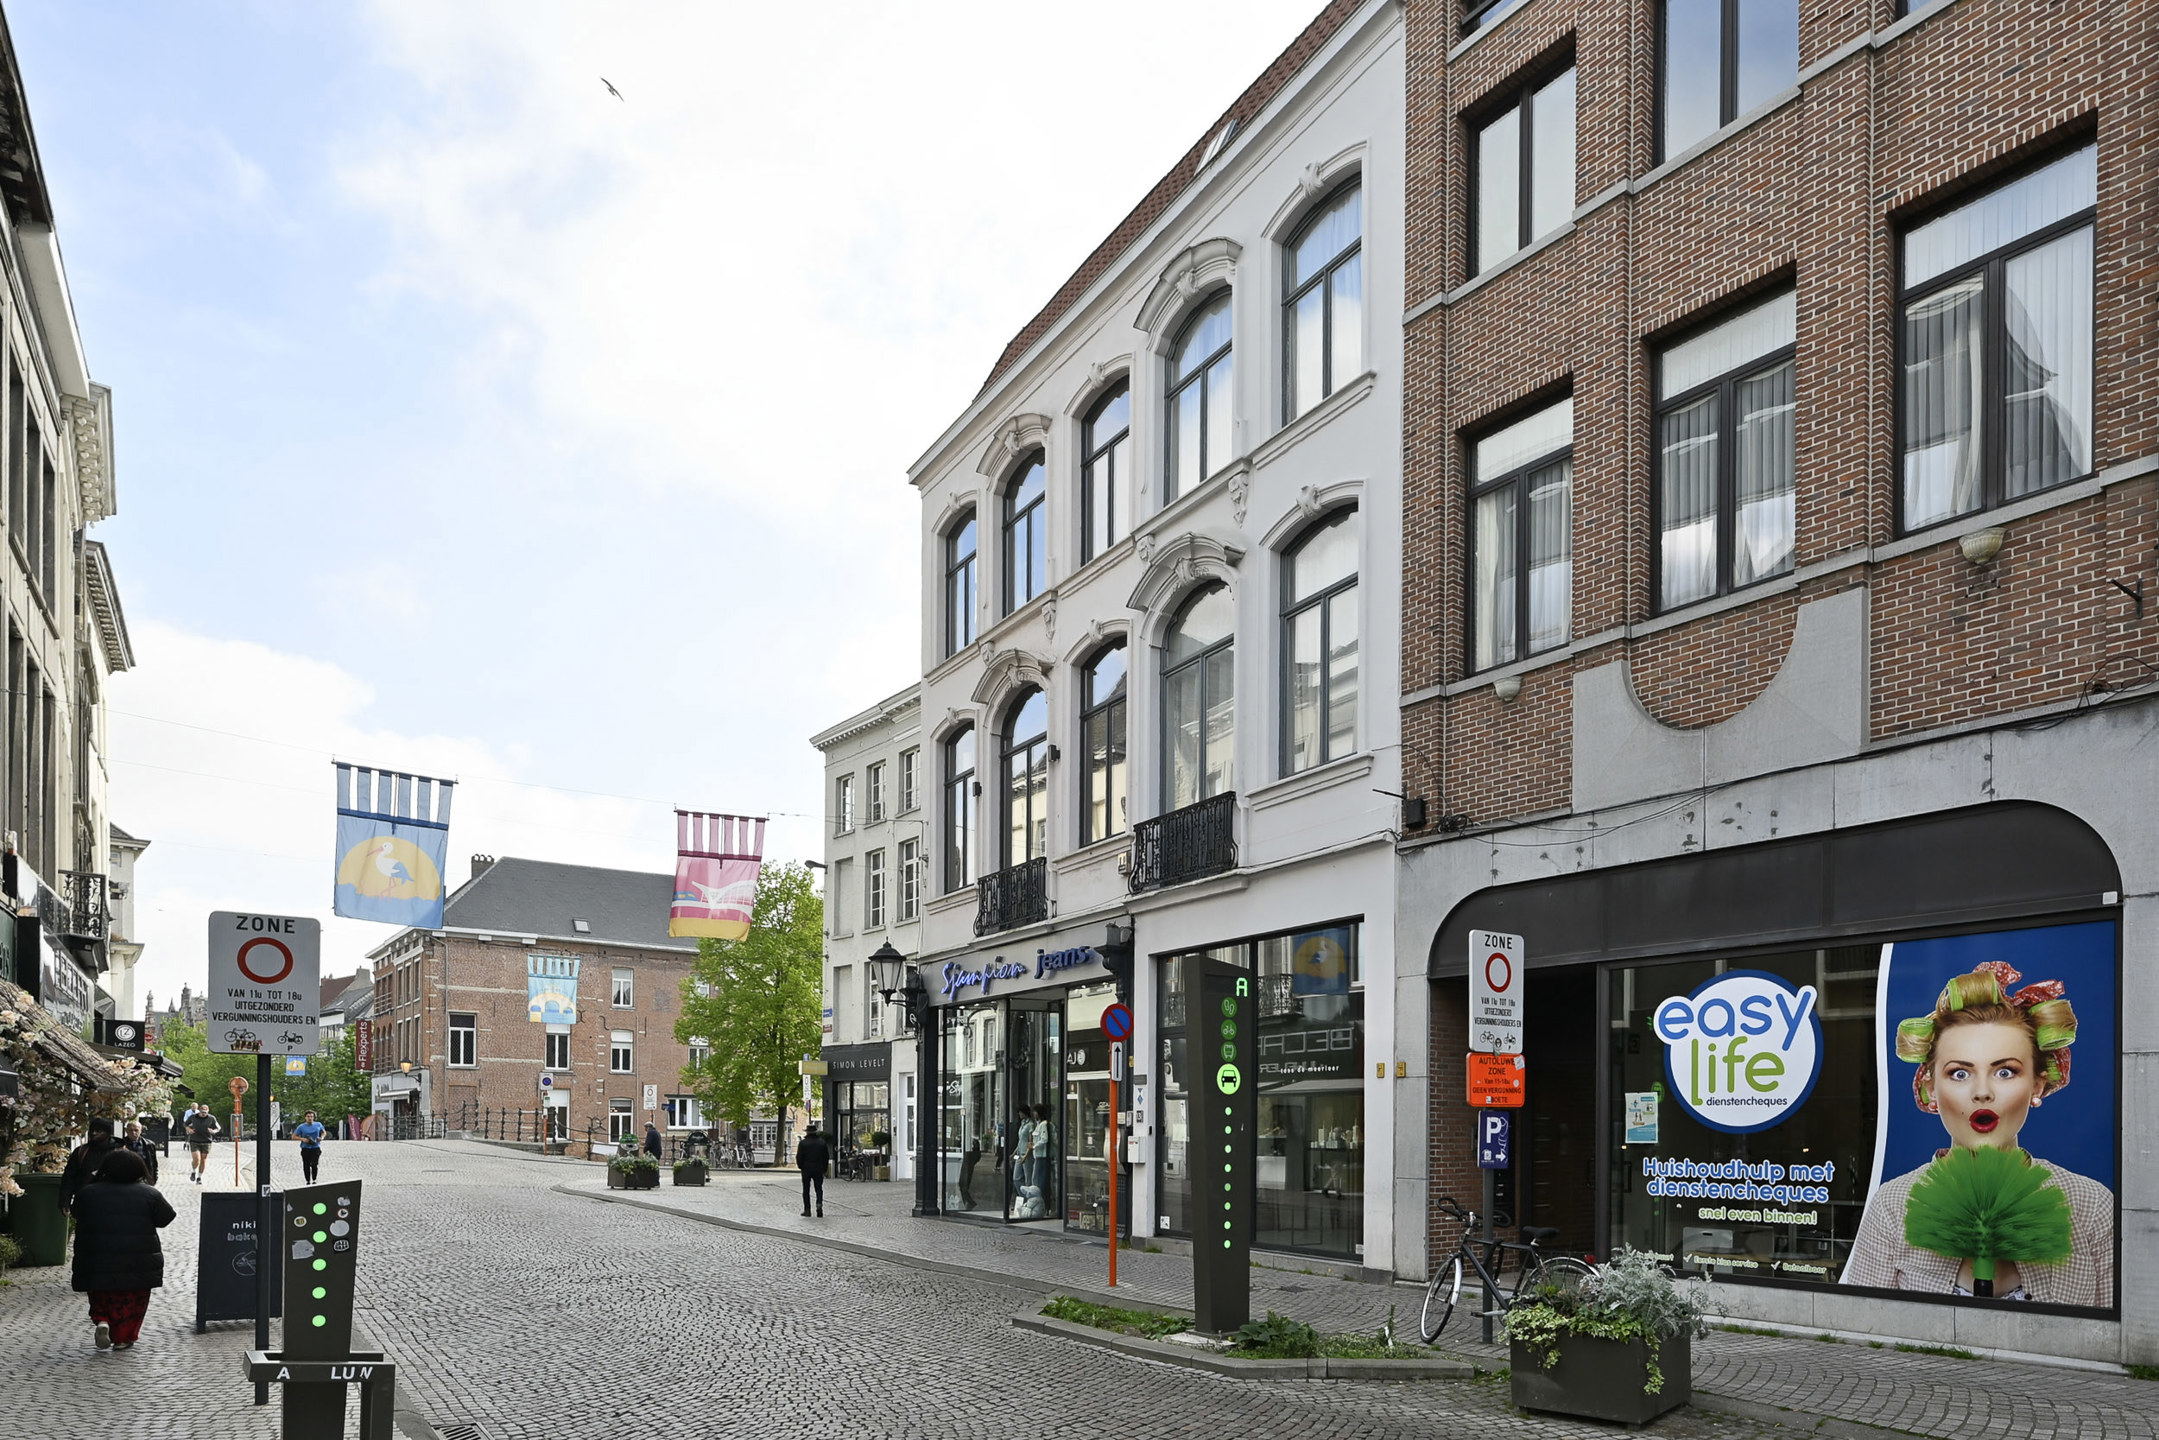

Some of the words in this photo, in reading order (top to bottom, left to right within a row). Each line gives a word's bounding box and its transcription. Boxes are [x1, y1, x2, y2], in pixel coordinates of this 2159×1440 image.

[236, 915, 296, 934] ZONE
[1484, 934, 1513, 950] ZONE
[941, 956, 1027, 1001] Sjampion
[1034, 945, 1091, 980] jeans
[227, 988, 245, 998] VAN
[250, 989, 262, 999] 11u
[267, 990, 283, 1000] TOT
[288, 991, 302, 1001] 18u
[1480, 996, 1490, 1004] VAN
[1499, 997, 1507, 1006] TOT
[234, 1001, 295, 1012] UITGEZONDERD
[212, 1012, 303, 1025] VERGUNNINGSHOUDERS
[306, 1016, 316, 1025] EN
[1658, 991, 1811, 1051] easy
[359, 1021, 369, 1062] Flexperts
[833, 1060, 855, 1069] SIMON
[859, 1058, 885, 1068] LEVELT
[1479, 1057, 1515, 1065] AUTOLUWE
[1488, 1067, 1506, 1075] ZONE
[1691, 1036, 1785, 1106] life
[1706, 1096, 1788, 1107] dienstencheques
[1486, 1116, 1502, 1144] P
[1643, 1157, 1785, 1184] Huishoudhulp
[1790, 1160, 1835, 1182] met
[1647, 1177, 1829, 1206] dienstencheques
[1699, 1206, 1726, 1220] snel
[1728, 1209, 1761, 1222] even
[1763, 1208, 1818, 1225] binnen!
[1694, 1255, 1716, 1265] Eerste
[1716, 1256, 1731, 1267] klas
[1732, 1259, 1759, 1269] service
[1783, 1262, 1827, 1274] Betaalbaar
